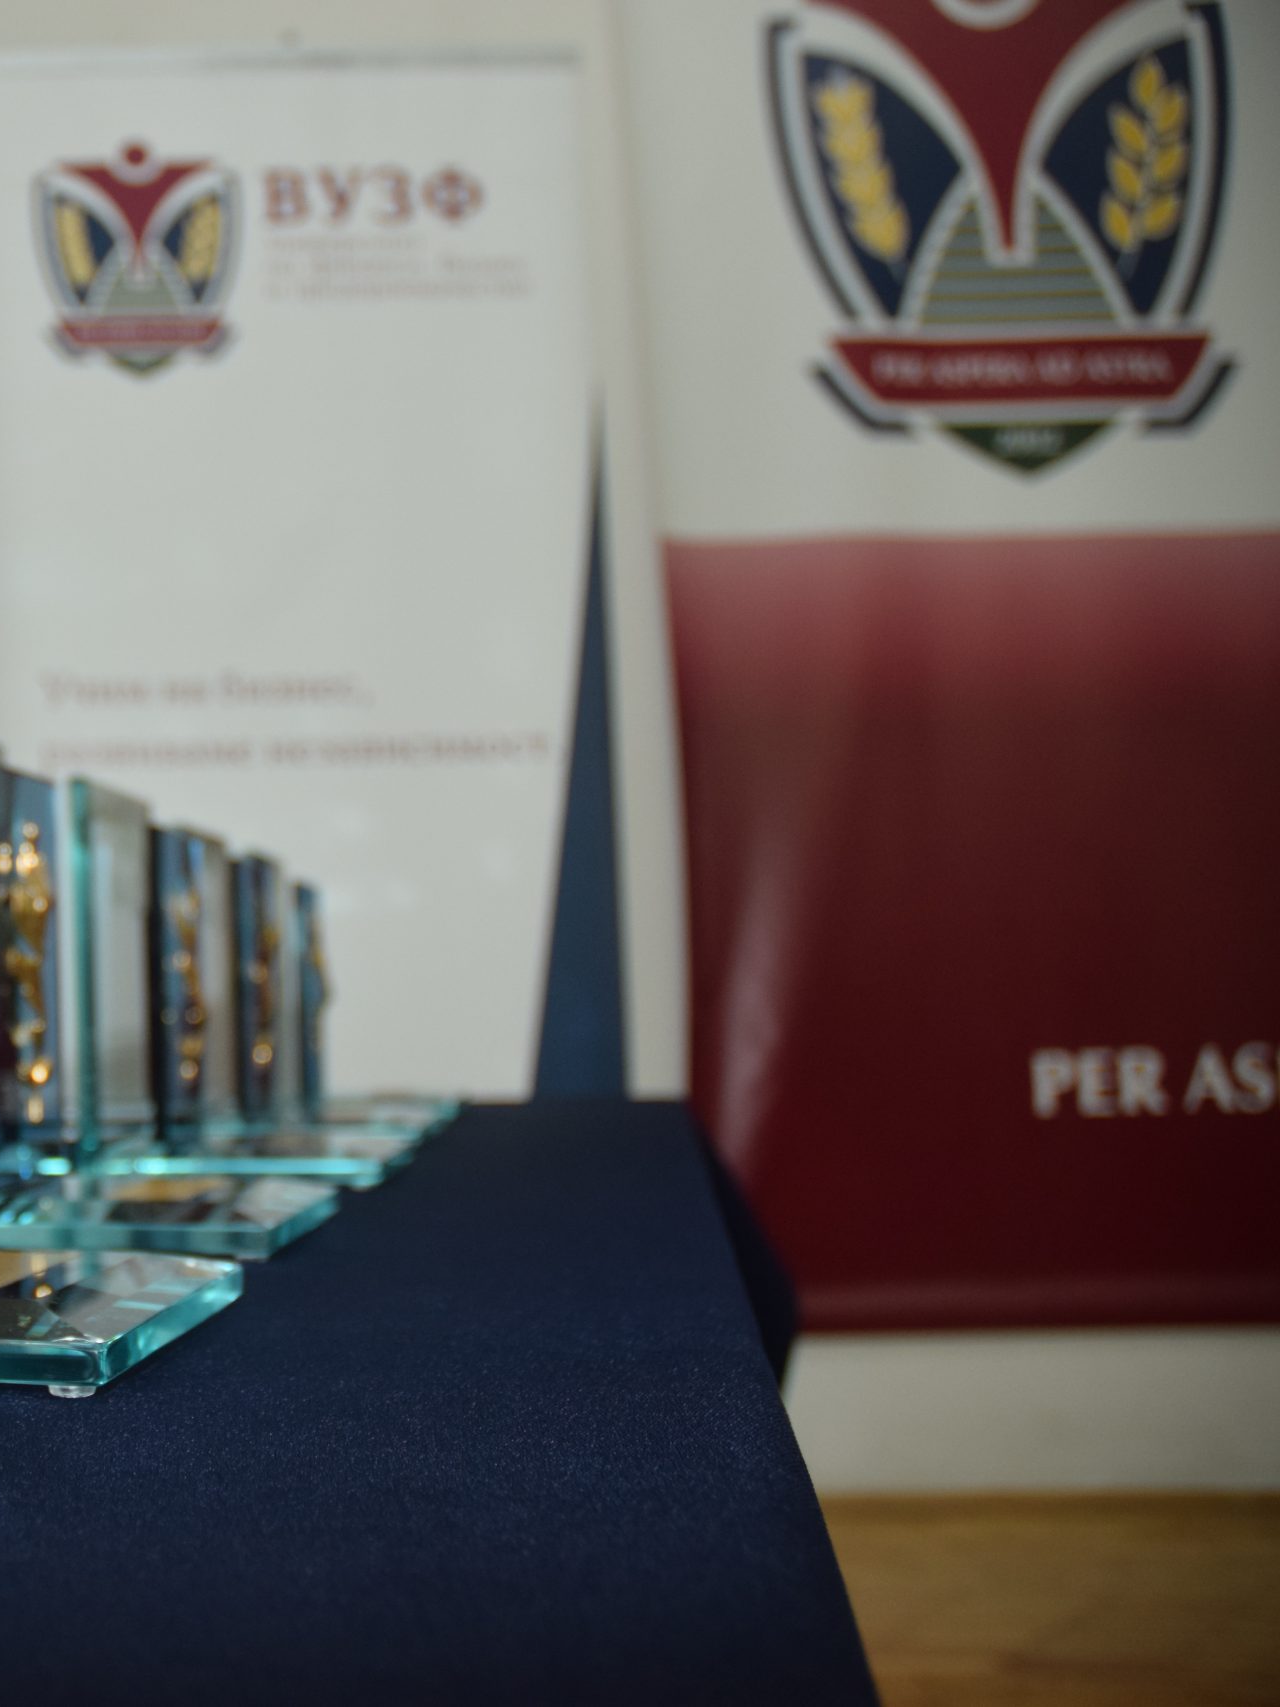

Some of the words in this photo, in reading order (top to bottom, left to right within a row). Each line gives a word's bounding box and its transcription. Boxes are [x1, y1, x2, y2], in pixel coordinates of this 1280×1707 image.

[262, 165, 484, 230] ВУЗФ
[1031, 1047, 1169, 1119] PER
[1183, 1041, 1280, 1115] AS
